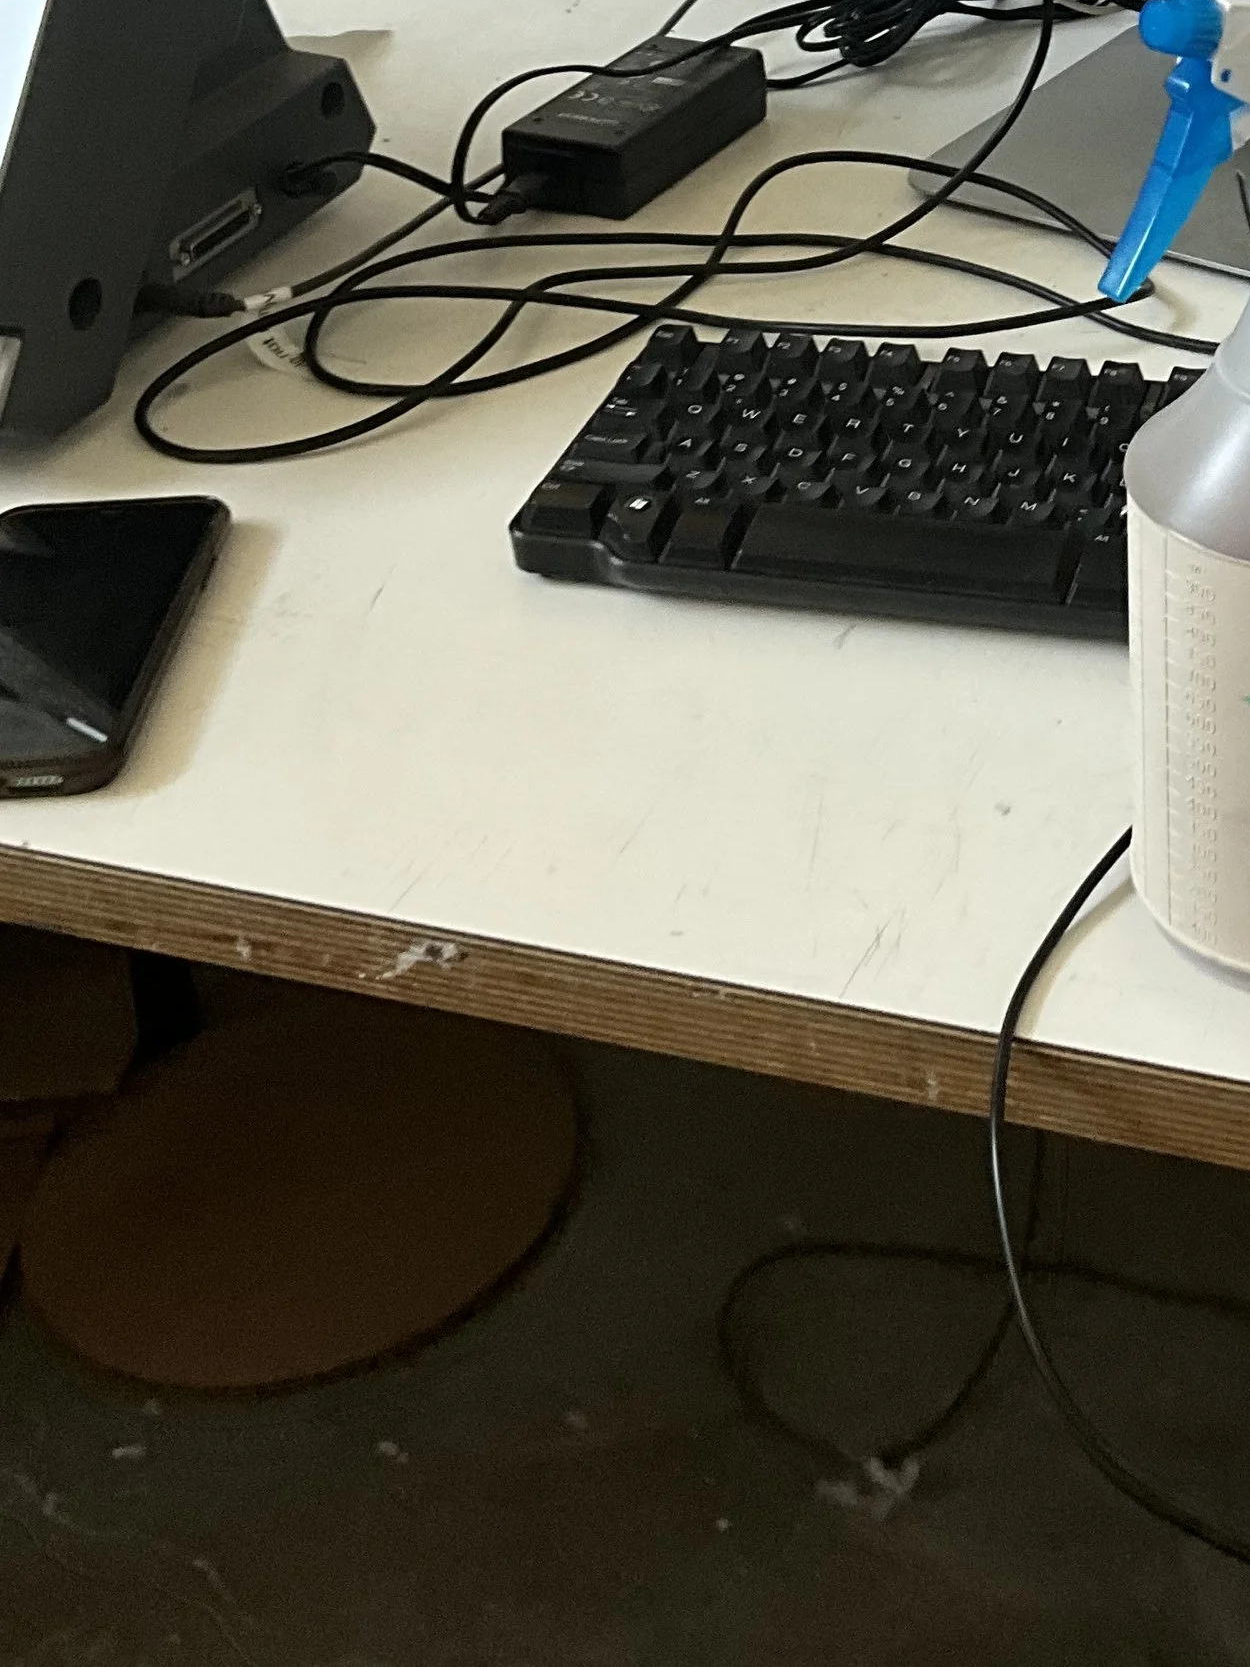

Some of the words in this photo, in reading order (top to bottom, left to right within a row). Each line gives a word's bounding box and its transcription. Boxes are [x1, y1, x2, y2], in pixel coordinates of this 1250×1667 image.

[742, 408, 762, 420] W
[792, 413, 808, 424] E
[902, 423, 914, 433] T
[957, 427, 971, 438] Y
[677, 437, 693, 448] A
[1008, 432, 1024, 444] U
[787, 447, 804, 457] D
[841, 452, 857, 462] F
[951, 462, 967, 473] H
[1007, 467, 1021, 478] J
[685, 469, 701, 479] Z
[1062, 472, 1078, 483] K
[855, 485, 870, 495] V
[963, 495, 981, 507] N
[1020, 500, 1038, 512] M
